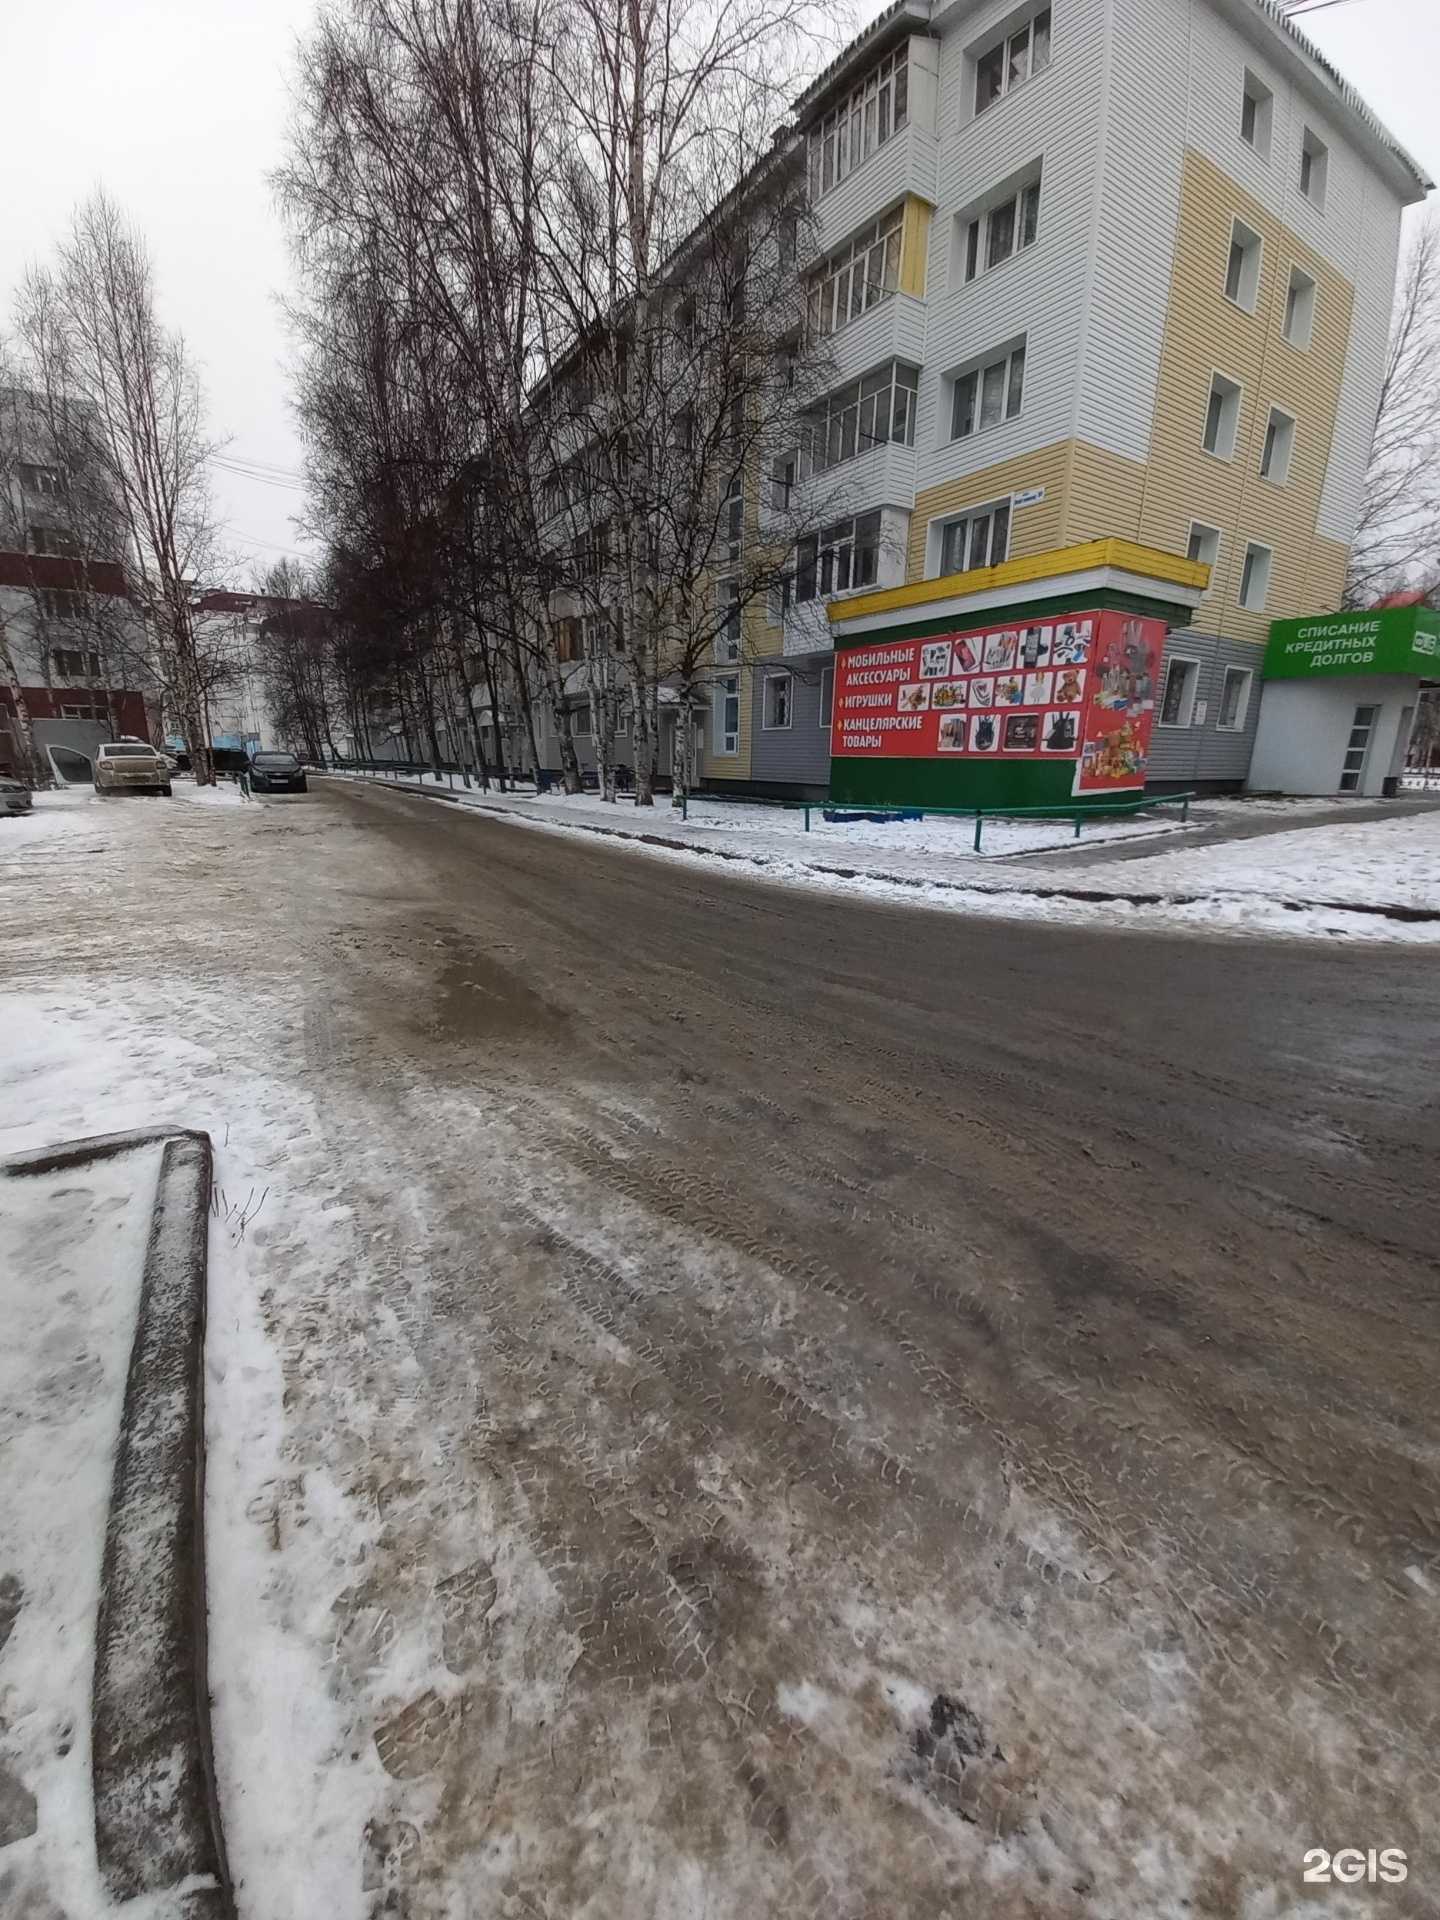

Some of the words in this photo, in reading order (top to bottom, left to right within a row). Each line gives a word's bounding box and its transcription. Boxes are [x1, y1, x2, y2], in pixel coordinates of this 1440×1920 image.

[1298, 620, 1381, 639] СПИСАНИЕ
[1285, 636, 1377, 654] КРЕДИТНЫХ
[847, 648, 915, 669] МОБИЛЬНЫЕ
[1310, 651, 1374, 667] ДОЛГОВ
[846, 668, 911, 686] АКСЕССУАРЫ
[845, 693, 892, 708] ИГРУШКИ
[843, 716, 923, 732] КАНЦЕЛЯРСКИЕ
[842, 735, 881, 748] ТОВАРЫ
